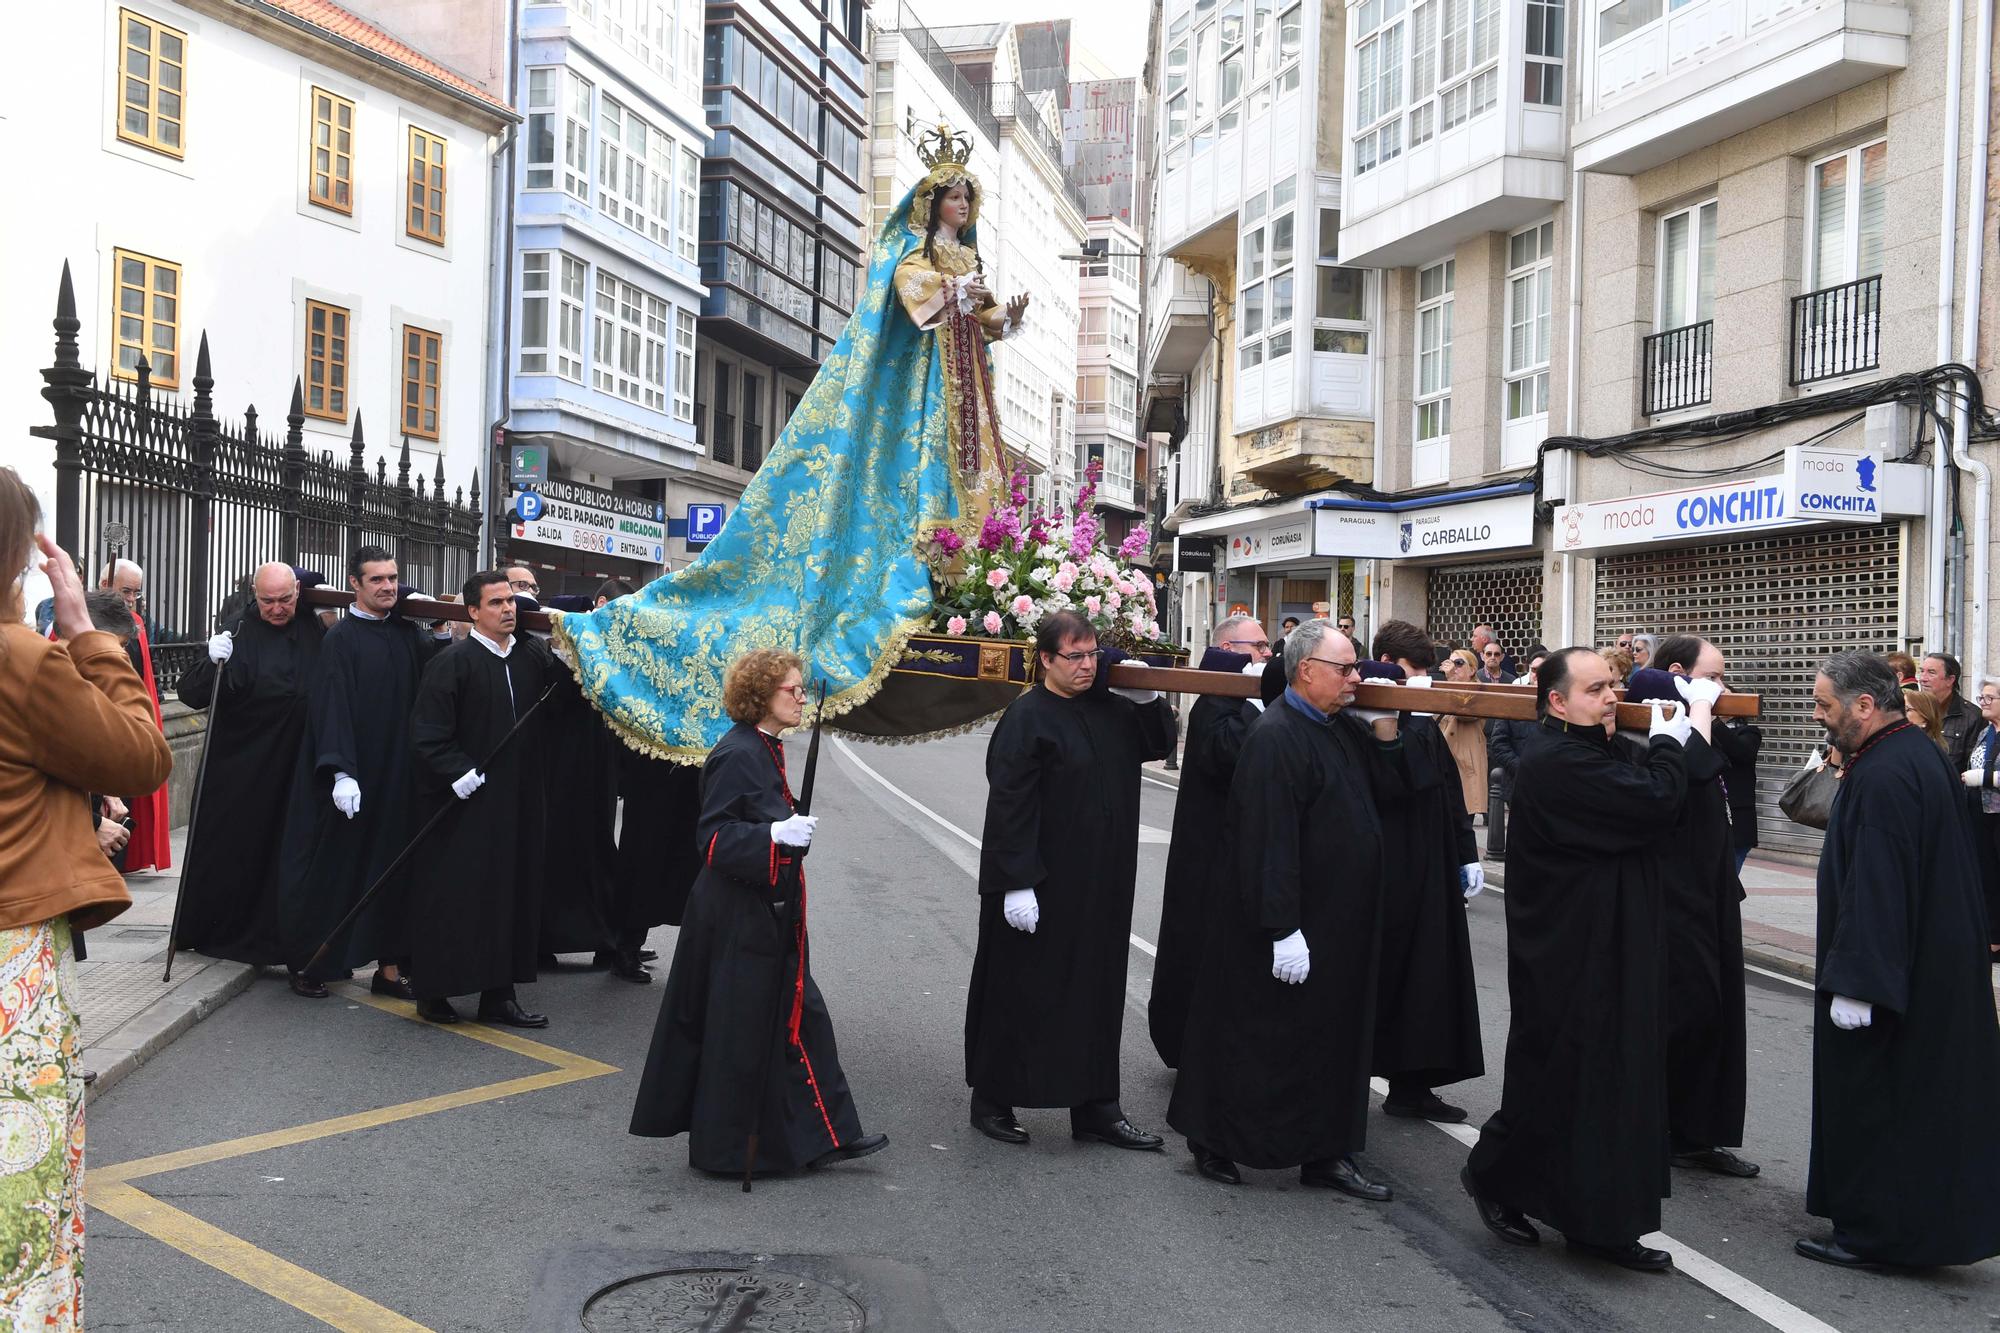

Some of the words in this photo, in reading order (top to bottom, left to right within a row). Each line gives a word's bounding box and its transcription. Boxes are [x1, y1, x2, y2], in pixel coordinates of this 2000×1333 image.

[1803, 458, 1844, 473] moda
[523, 496, 537, 516] P
[530, 481, 572, 500] PARKING
[574, 486, 612, 510] PÚBLICO
[613, 497, 624, 513] 24
[625, 499, 653, 518] HORAS
[1801, 493, 1876, 512] CONCHITA
[558, 505, 572, 521] DEL
[574, 509, 615, 530] PAPAGAYO
[620, 519, 662, 539] MERCADONA
[696, 507, 715, 532] P
[1340, 517, 1376, 525] PARAGUAS
[1415, 515, 1441, 526] PARAGUAS
[1603, 503, 1654, 530] moda
[537, 525, 562, 541] SALIDA
[620, 542, 648, 556] ENTRADA
[1271, 531, 1302, 546] CORUÑASIA
[1422, 525, 1491, 546] CARBALLO
